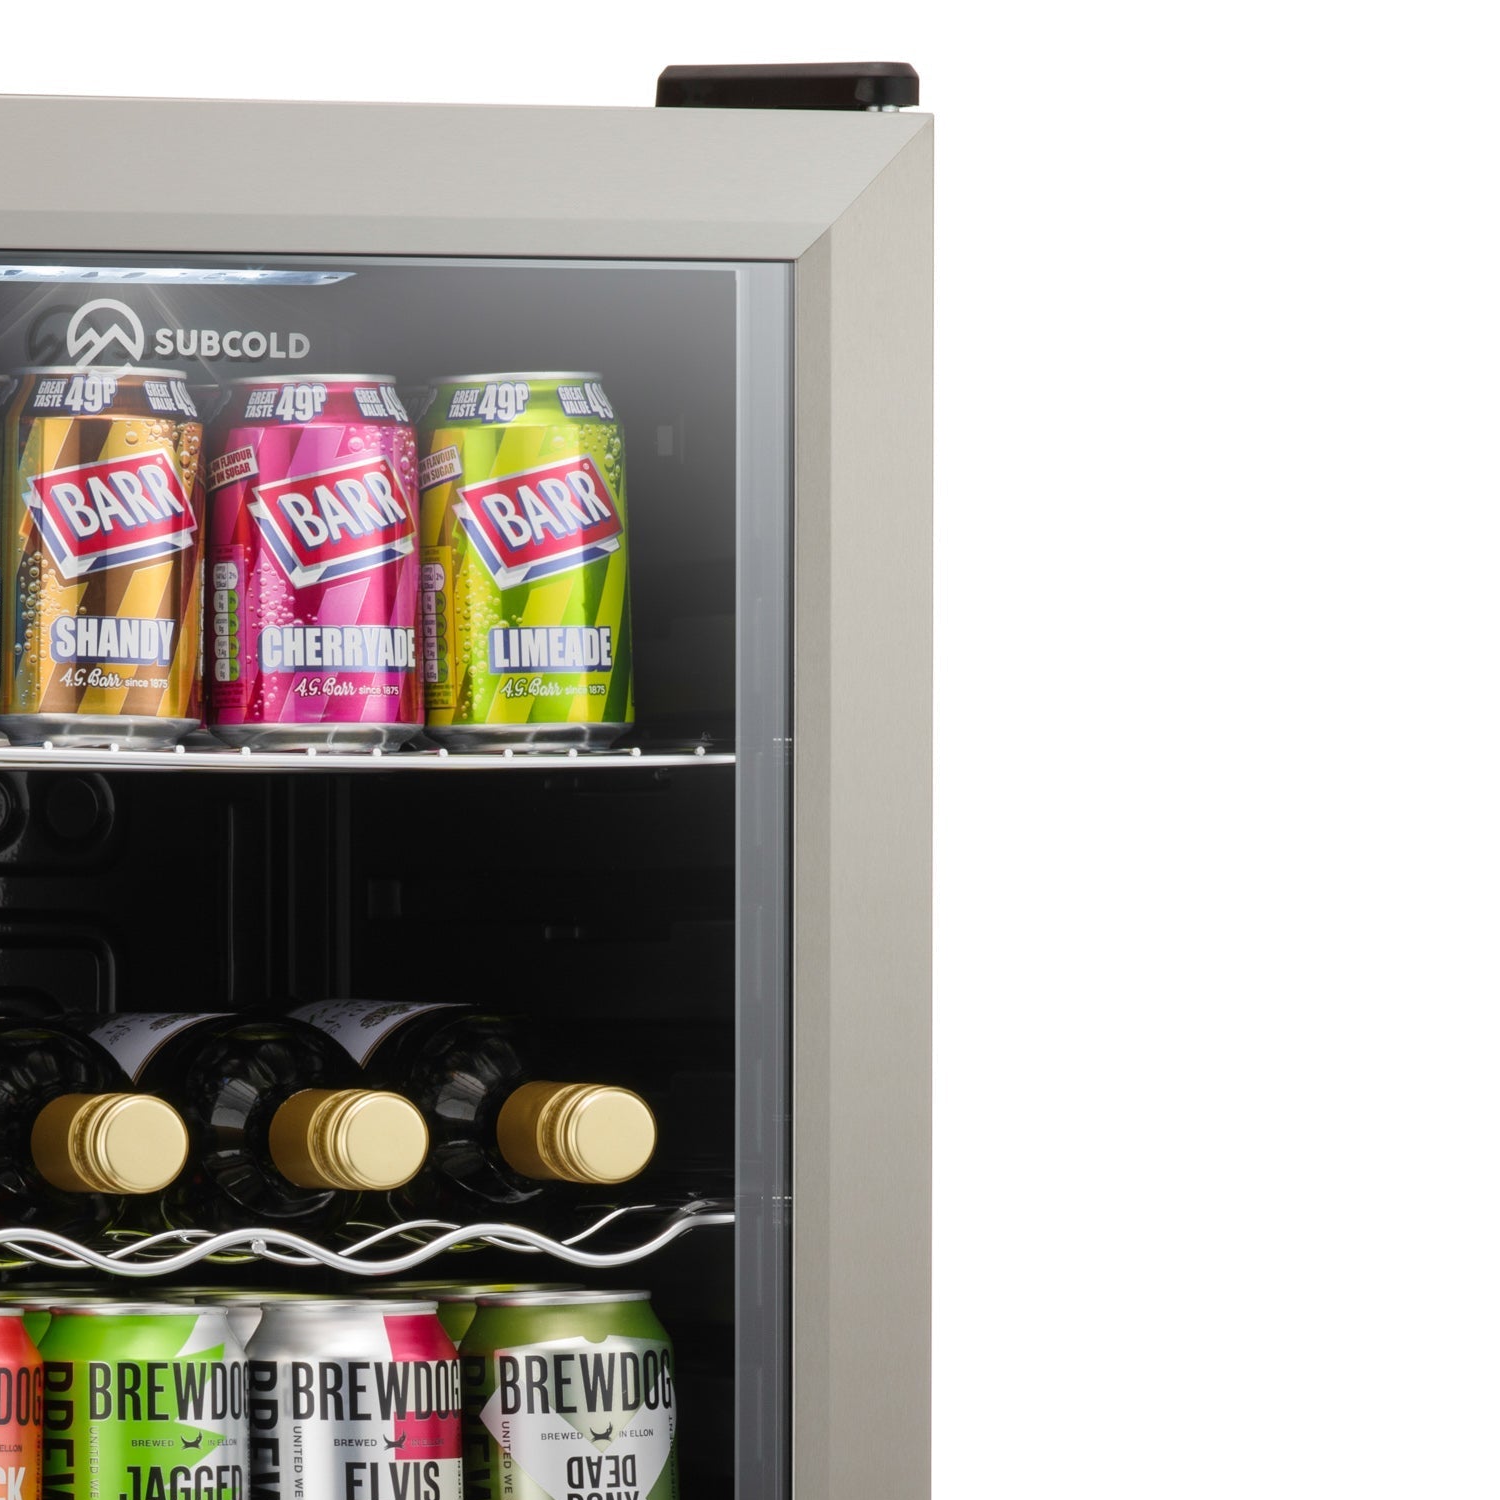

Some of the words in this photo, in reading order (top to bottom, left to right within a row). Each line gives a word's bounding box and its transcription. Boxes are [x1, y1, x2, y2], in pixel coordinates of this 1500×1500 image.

[154, 329, 310, 358] SUBCOLD
[38, 380, 66, 394] GREAT
[558, 386, 584, 401] GREAT
[34, 394, 62, 407] TASTE
[249, 391, 277, 404] GREAT
[452, 390, 479, 404] GREAT
[245, 405, 273, 418] TASTE
[449, 404, 476, 418] TASTE
[225, 462, 251, 480] SUGAR
[50, 464, 184, 538] BARR
[277, 470, 407, 547] BARR
[482, 469, 611, 548] BARR
[56, 616, 177, 660] SHANDY
[262, 626, 415, 668] CHERRYADE
[493, 627, 612, 668] LIMEADE
[589, 685, 606, 695] 1875
[292, 1359, 461, 1421] BREWDOG
[500, 1349, 672, 1415] BREWDOG
[131, 1439, 174, 1447] BREWED
[334, 1439, 378, 1447] BREWED
[541, 1432, 584, 1441] BREWED
[619, 1430, 628, 1438] IN
[630, 1429, 654, 1437] ELLON
[0, 1445, 23, 1453] ELLON
[501, 1421, 512, 1469] UNITED
[567, 1454, 637, 1489] DEAD
[504, 1474, 513, 1494] WE
